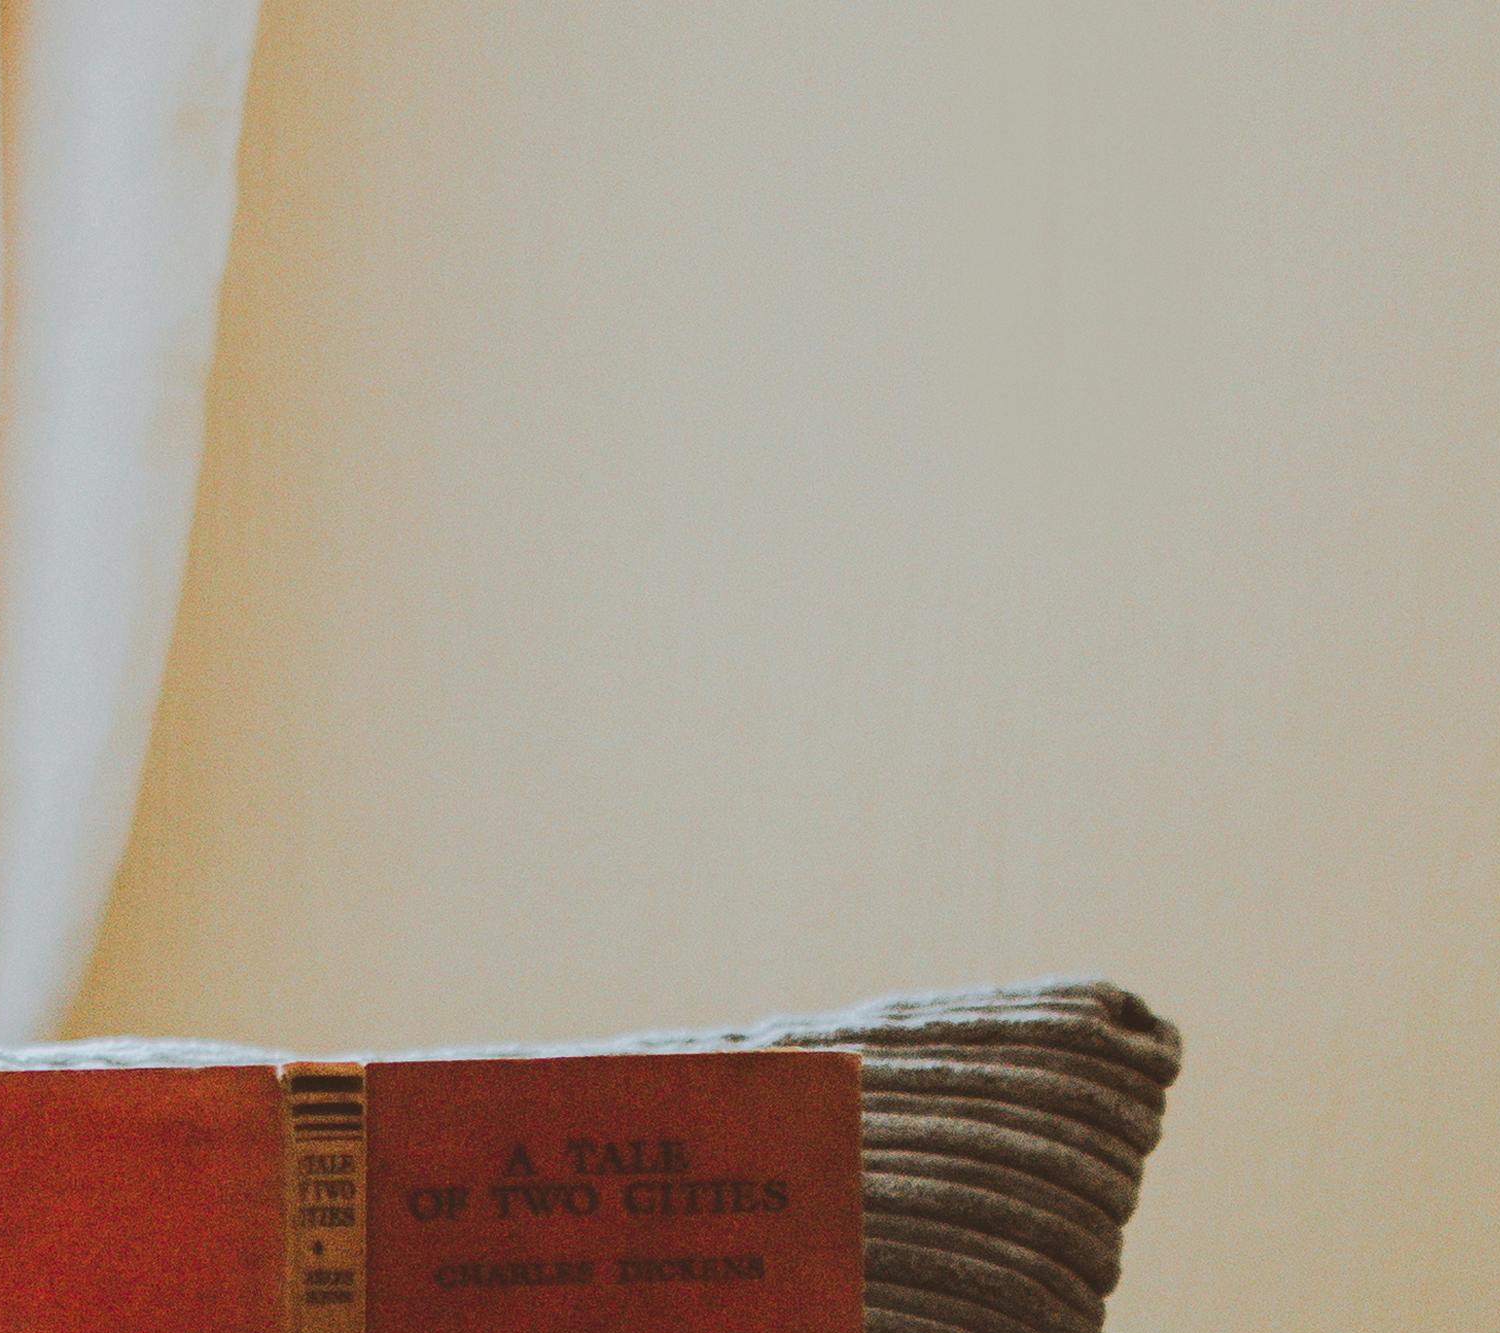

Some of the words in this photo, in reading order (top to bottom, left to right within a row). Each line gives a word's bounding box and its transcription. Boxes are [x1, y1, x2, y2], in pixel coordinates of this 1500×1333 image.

[503, 1143, 539, 1176] A
[566, 1136, 691, 1175] TALE
[406, 1186, 471, 1222] OF
[487, 1182, 600, 1218] TWO
[621, 1179, 790, 1216] CITIES
[433, 1259, 594, 1290] CHARLES
[616, 1254, 765, 1284] DICKENS
